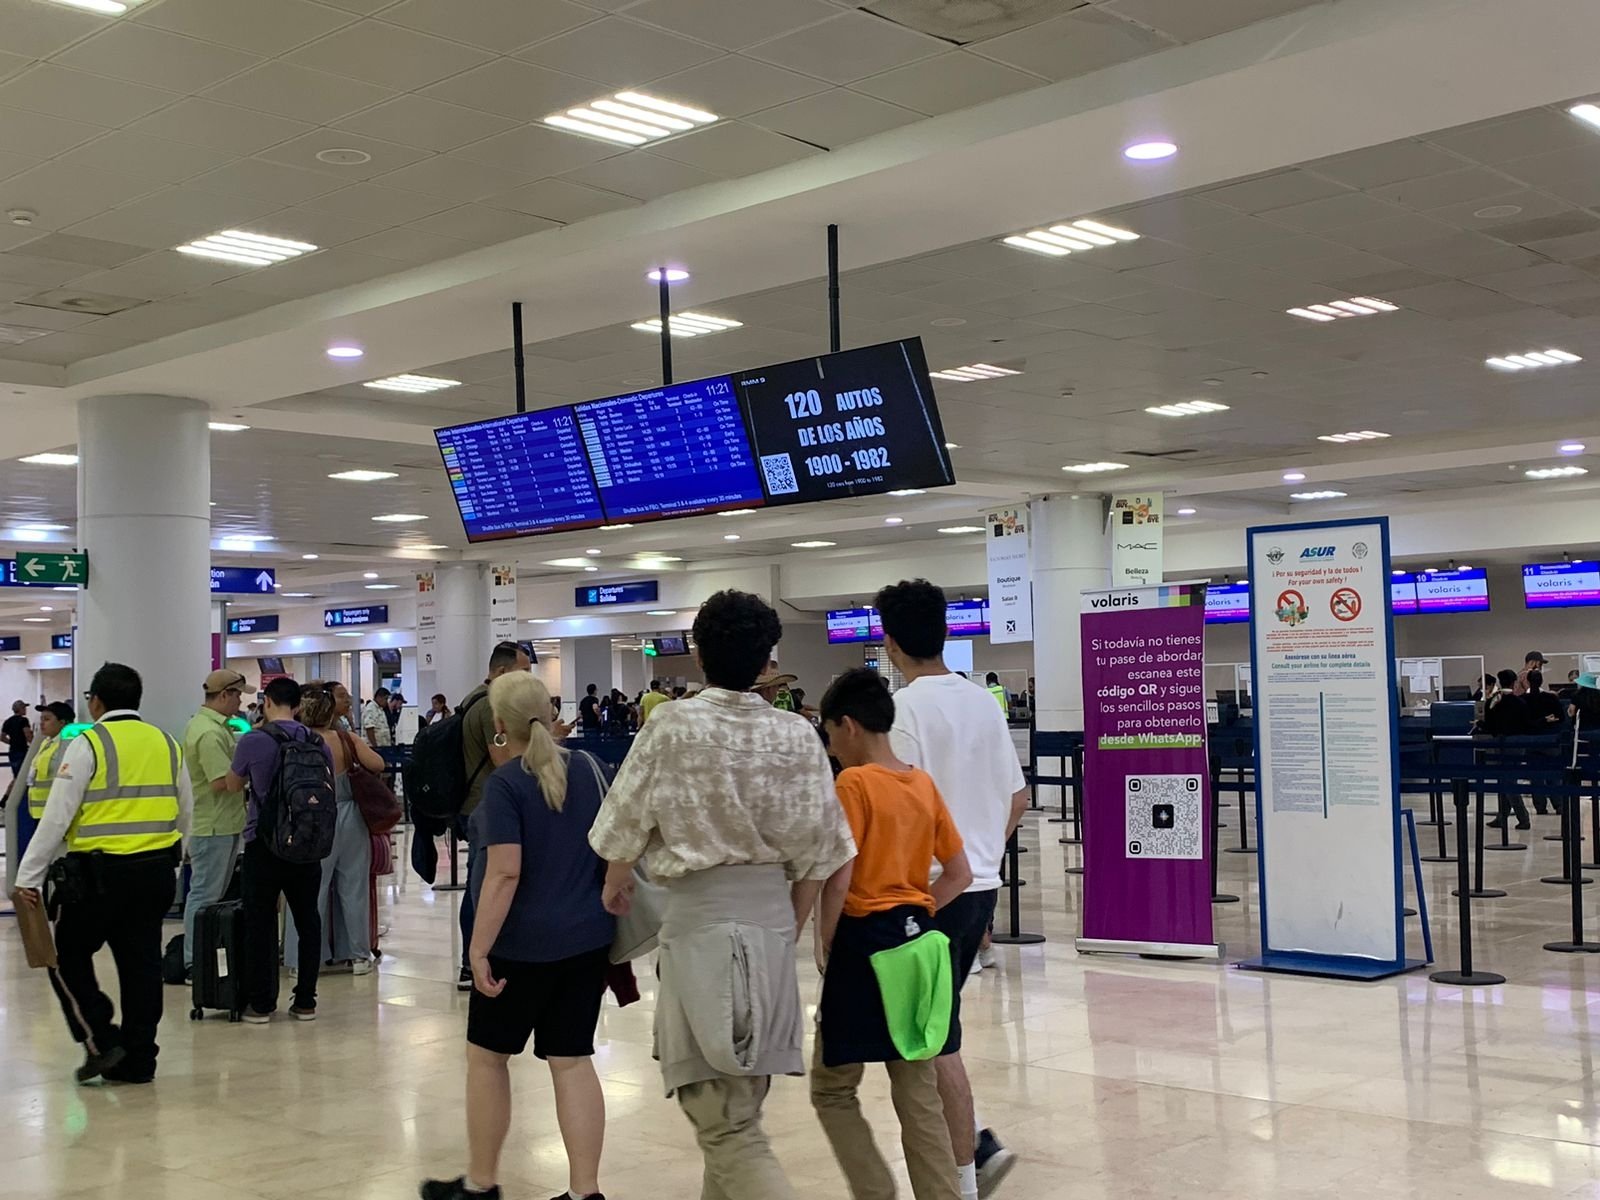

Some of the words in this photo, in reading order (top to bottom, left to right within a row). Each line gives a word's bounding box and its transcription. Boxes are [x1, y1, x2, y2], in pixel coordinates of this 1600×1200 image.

[704, 382, 729, 396] 11:21
[784, 389, 822, 419] 120
[836, 386, 884, 412] AUTOS
[551, 415, 573, 427] 11:21
[797, 427, 817, 447] DE
[819, 422, 845, 445] LOS
[846, 417, 886, 440] AÑOS
[805, 454, 842, 477] 1900
[851, 447, 891, 471] 1982
[1300, 546, 1336, 558] ASUR
[1294, 568, 1322, 577] seguridad
[1537, 579, 1572, 587] volaris
[1091, 593, 1139, 608] volaris
[1092, 639, 1102, 650] Si
[1104, 636, 1145, 649] todavía
[1148, 637, 1163, 646] no
[1166, 635, 1201, 645] tienes
[1096, 656, 1106, 666] tu
[1110, 656, 1136, 667] pase
[1138, 652, 1153, 663] de
[1127, 670, 1172, 680] escanea
[1176, 668, 1201, 677] este
[1097, 686, 1134, 699] código
[1138, 684, 1157, 696] QR
[1160, 686, 1167, 697] y
[1169, 683, 1201, 697] sigue
[1100, 702, 1115, 713] los
[1118, 700, 1165, 712] sencillos
[1168, 701, 1201, 713] pasos
[1117, 720, 1142, 730] para
[1144, 715, 1201, 727] obtenerlo
[1100, 734, 1134, 744] desde
[1138, 732, 1204, 746] WhatsApp.
